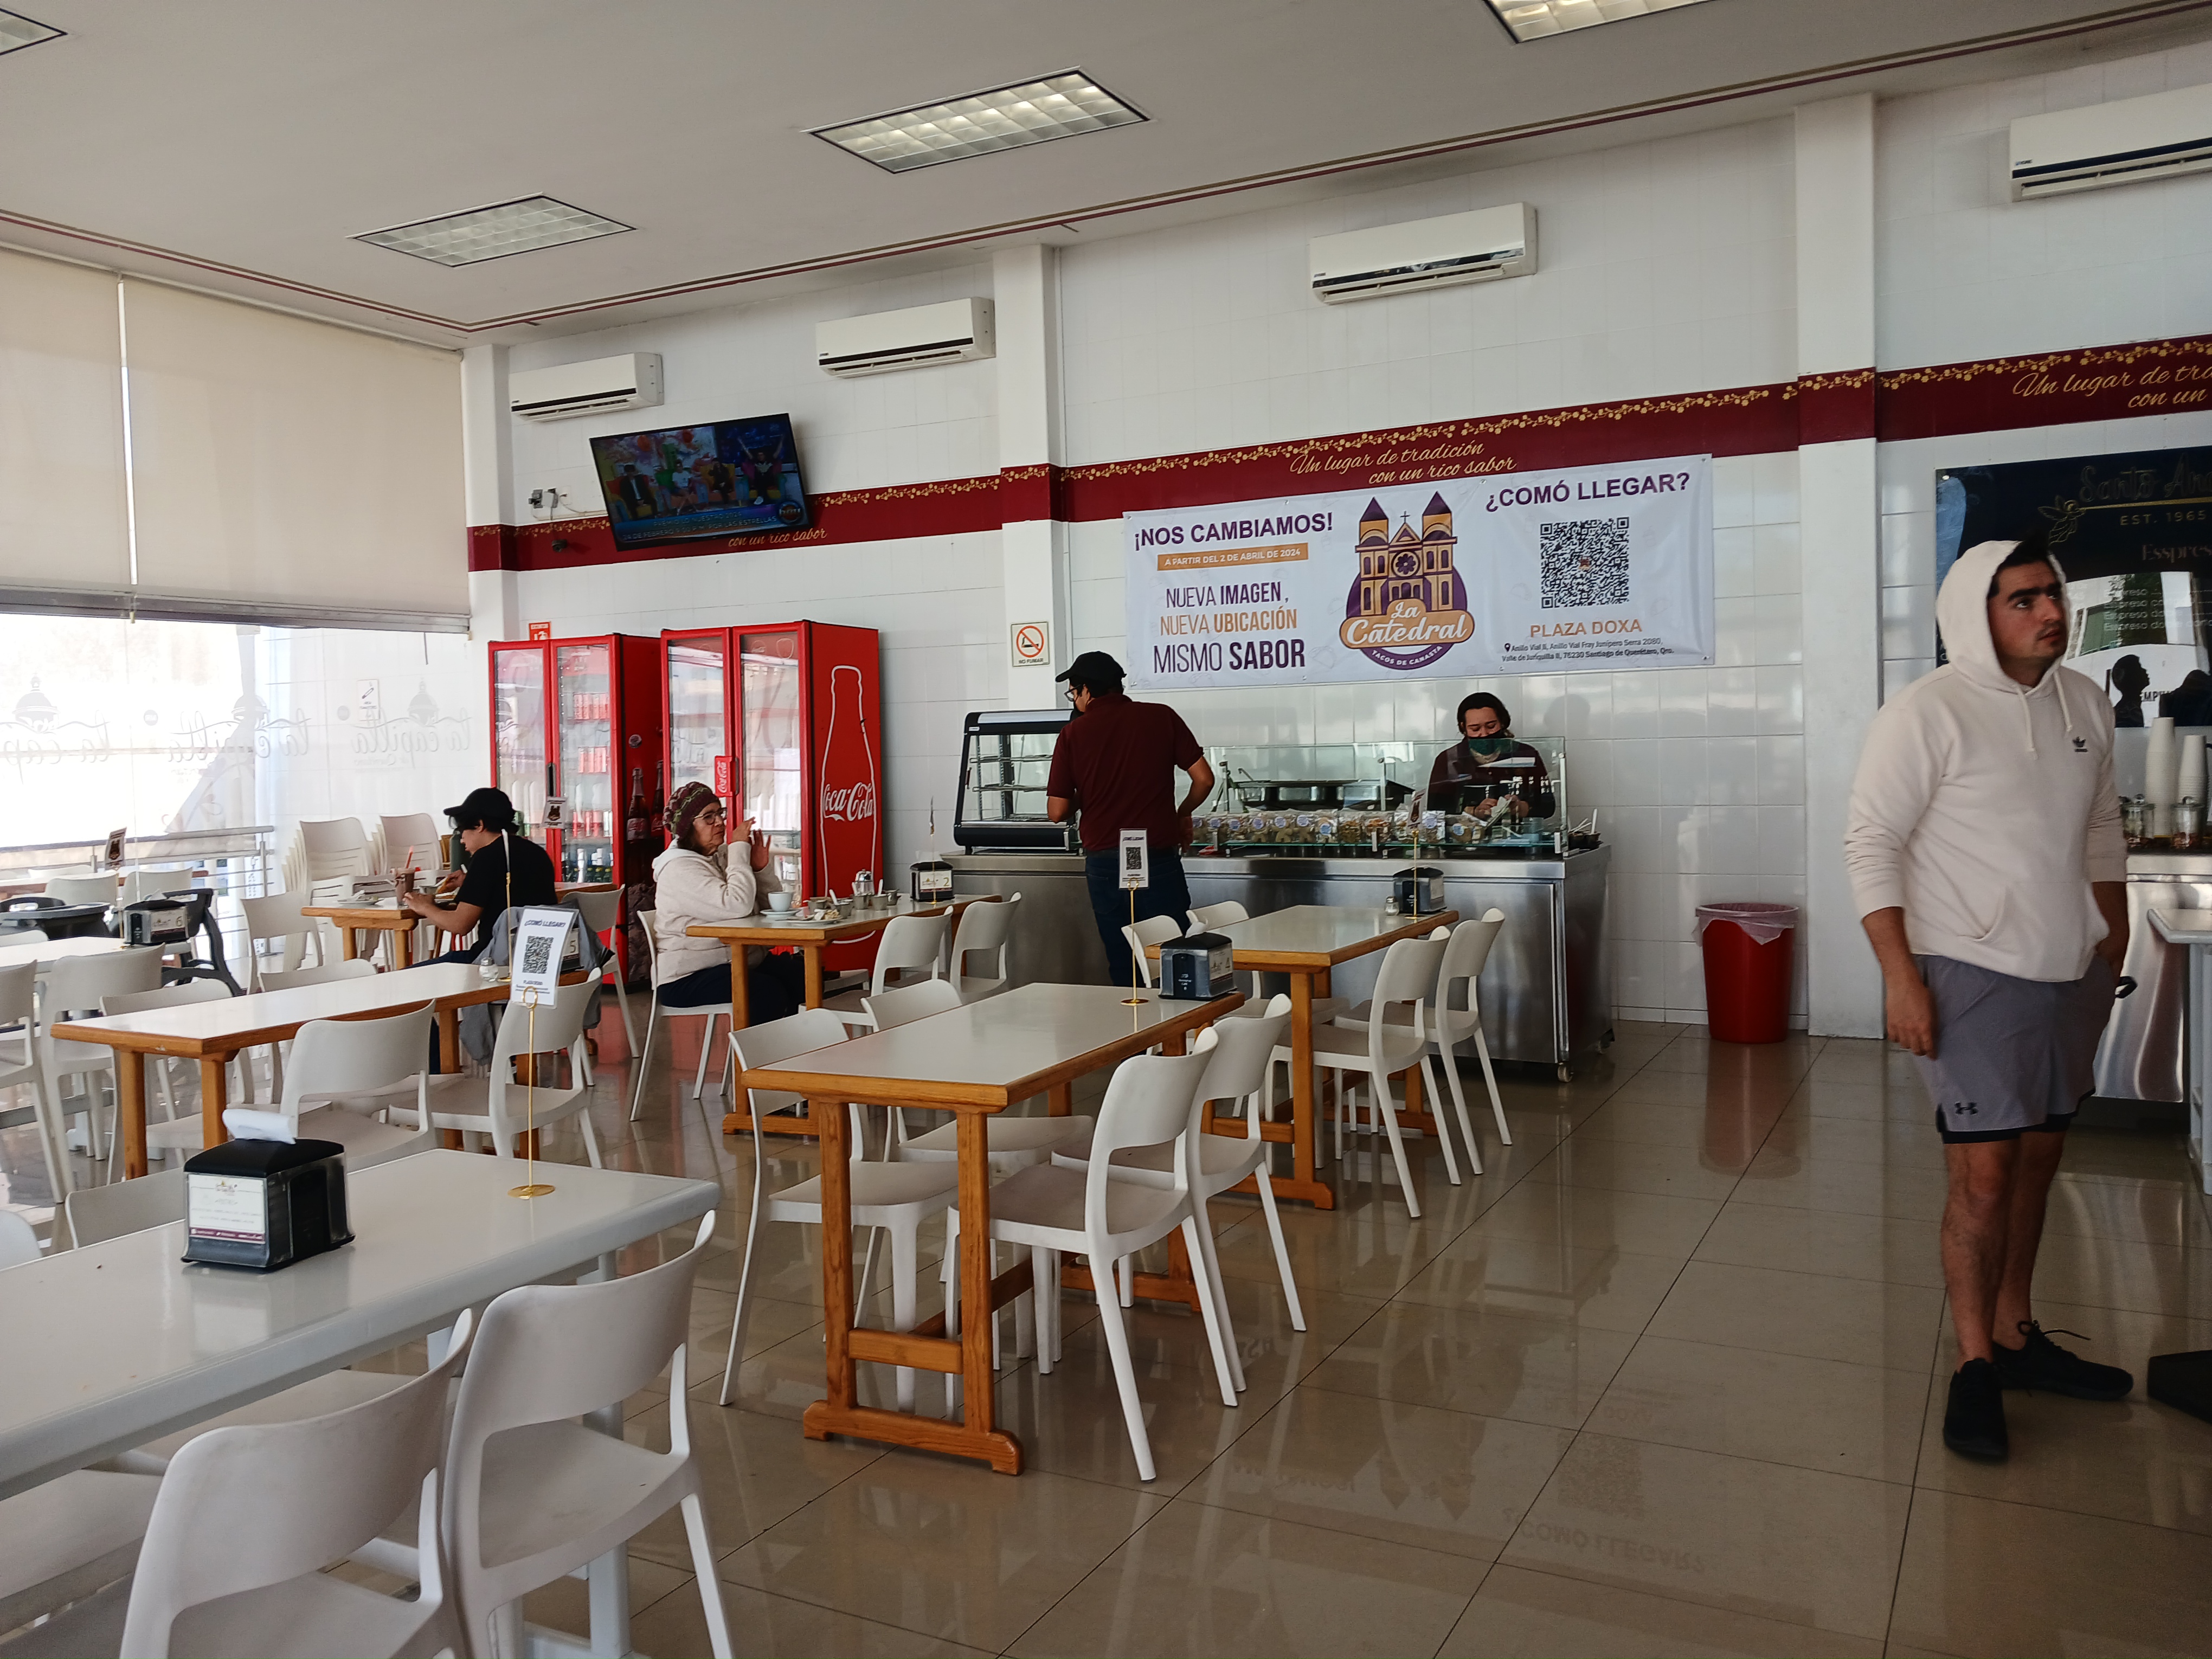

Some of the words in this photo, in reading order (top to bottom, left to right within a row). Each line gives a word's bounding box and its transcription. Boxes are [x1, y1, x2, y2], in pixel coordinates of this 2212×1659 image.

[2013, 373, 2059, 396] Un
[2063, 374, 2135, 396] lugar
[2139, 366, 2171, 385] de
[2174, 364, 2212, 382] tra
[2127, 392, 2168, 408] con
[2172, 388, 2208, 403] un
[1290, 454, 1322, 474] Un
[1324, 456, 1373, 475] lugar
[1378, 451, 1398, 465] de
[1401, 441, 1484, 462] tradición
[1369, 471, 1397, 484] con
[1399, 468, 1424, 481] un
[1428, 464, 1460, 478] rico
[1465, 457, 1517, 474] sabor
[1486, 480, 1570, 513] ¿COMÓ
[1578, 472, 1690, 500] LLEGAR?
[644, 529, 674, 538] FEBRERO
[739, 516, 777, 525] ESTRELLAS
[2120, 514, 2157, 526] EST.
[2166, 510, 2206, 522] 1965
[728, 538, 747, 547] con
[749, 537, 766, 545] un
[768, 533, 790, 543] rico
[793, 528, 827, 541] sabor
[1134, 527, 1186, 551] ¡NOS
[1191, 512, 1334, 543] CAMBIAMOS!
[1173, 556, 1201, 565] PARTIR
[1203, 555, 1217, 563] DEL
[1240, 551, 1265, 561] ABRIL
[1267, 550, 1278, 558] DE
[1280, 548, 1301, 557] 2024
[1166, 586, 1217, 608] NUEVA
[1391, 602, 1421, 619] La
[1160, 614, 1210, 636] NUEVA
[1213, 606, 1297, 633] UBICACIÓN
[1347, 614, 1468, 645] Catedral
[1530, 622, 1587, 638] PLAZA
[1592, 619, 1642, 635] DOXA
[1372, 650, 1394, 665] TACOS
[1409, 645, 1443, 665] CANASTA
[1581, 641, 1595, 649] Fray
[1153, 642, 1223, 673] MISMO
[1229, 638, 1306, 671] SABOR
[943, 877, 950, 886] 2
[175, 916, 182, 927] 6
[569, 940, 576, 953] 5
